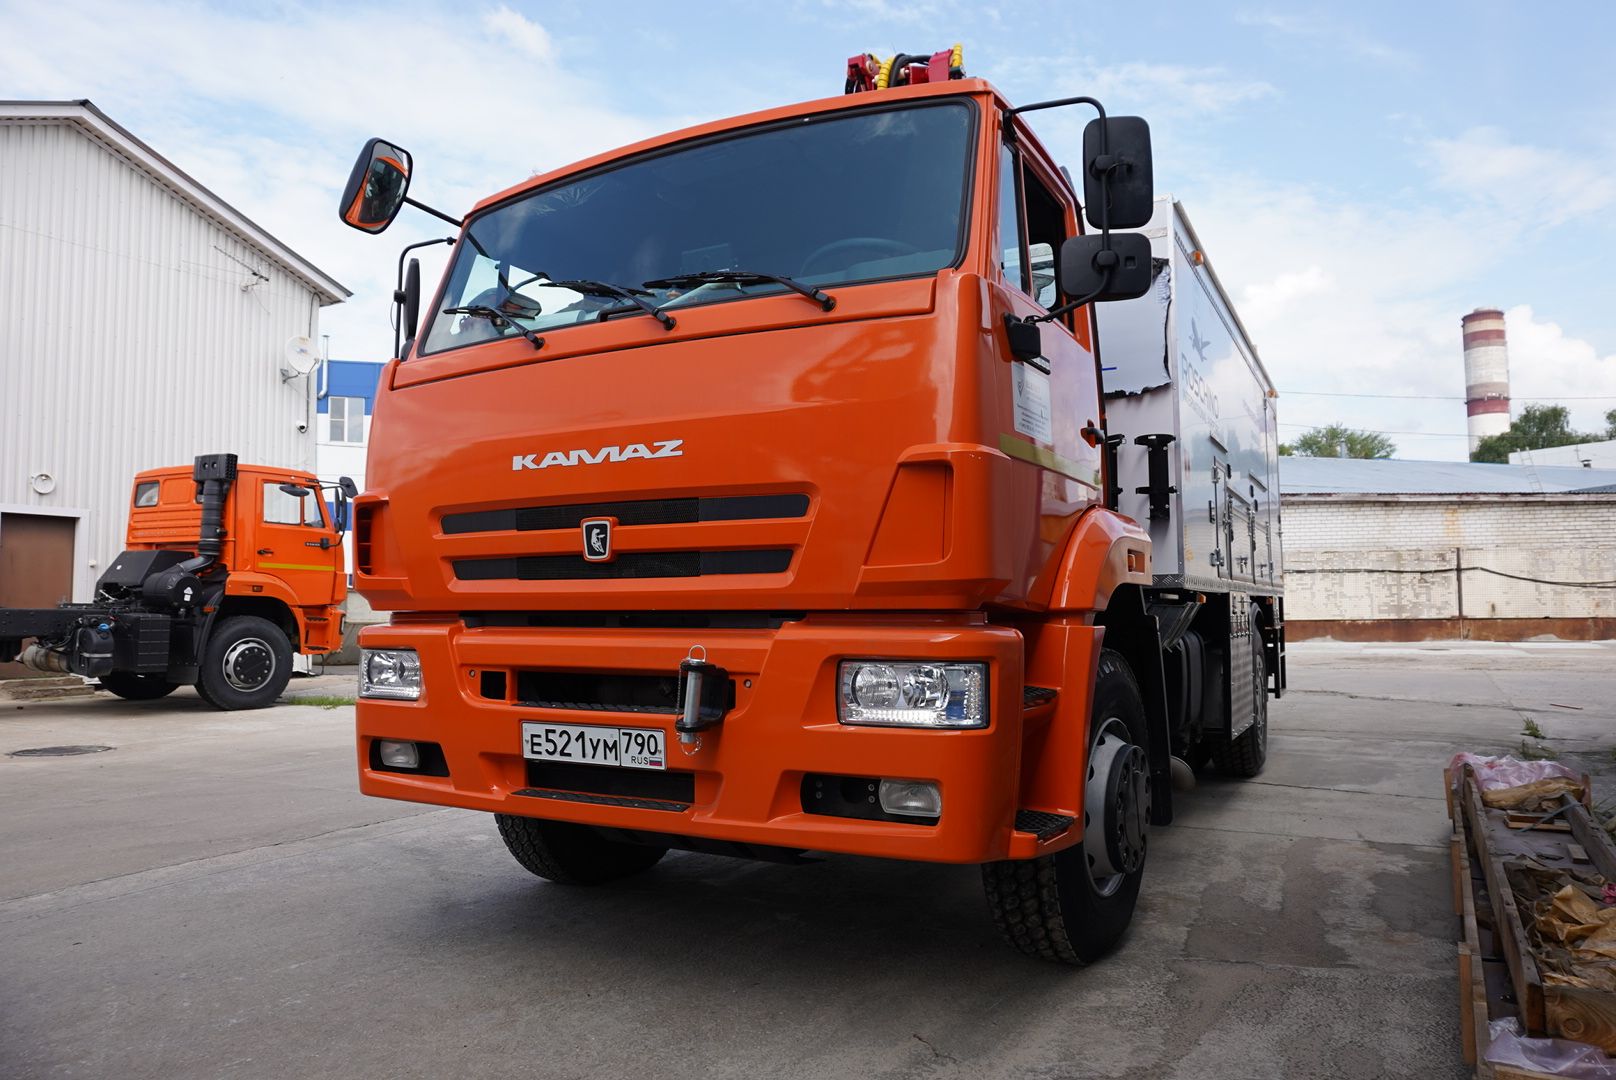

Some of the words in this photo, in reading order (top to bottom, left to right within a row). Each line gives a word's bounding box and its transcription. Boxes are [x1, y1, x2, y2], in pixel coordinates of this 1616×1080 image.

[512, 439, 683, 471] KAMAZ
[622, 732, 658, 756] 790
[631, 755, 649, 766] RUS
